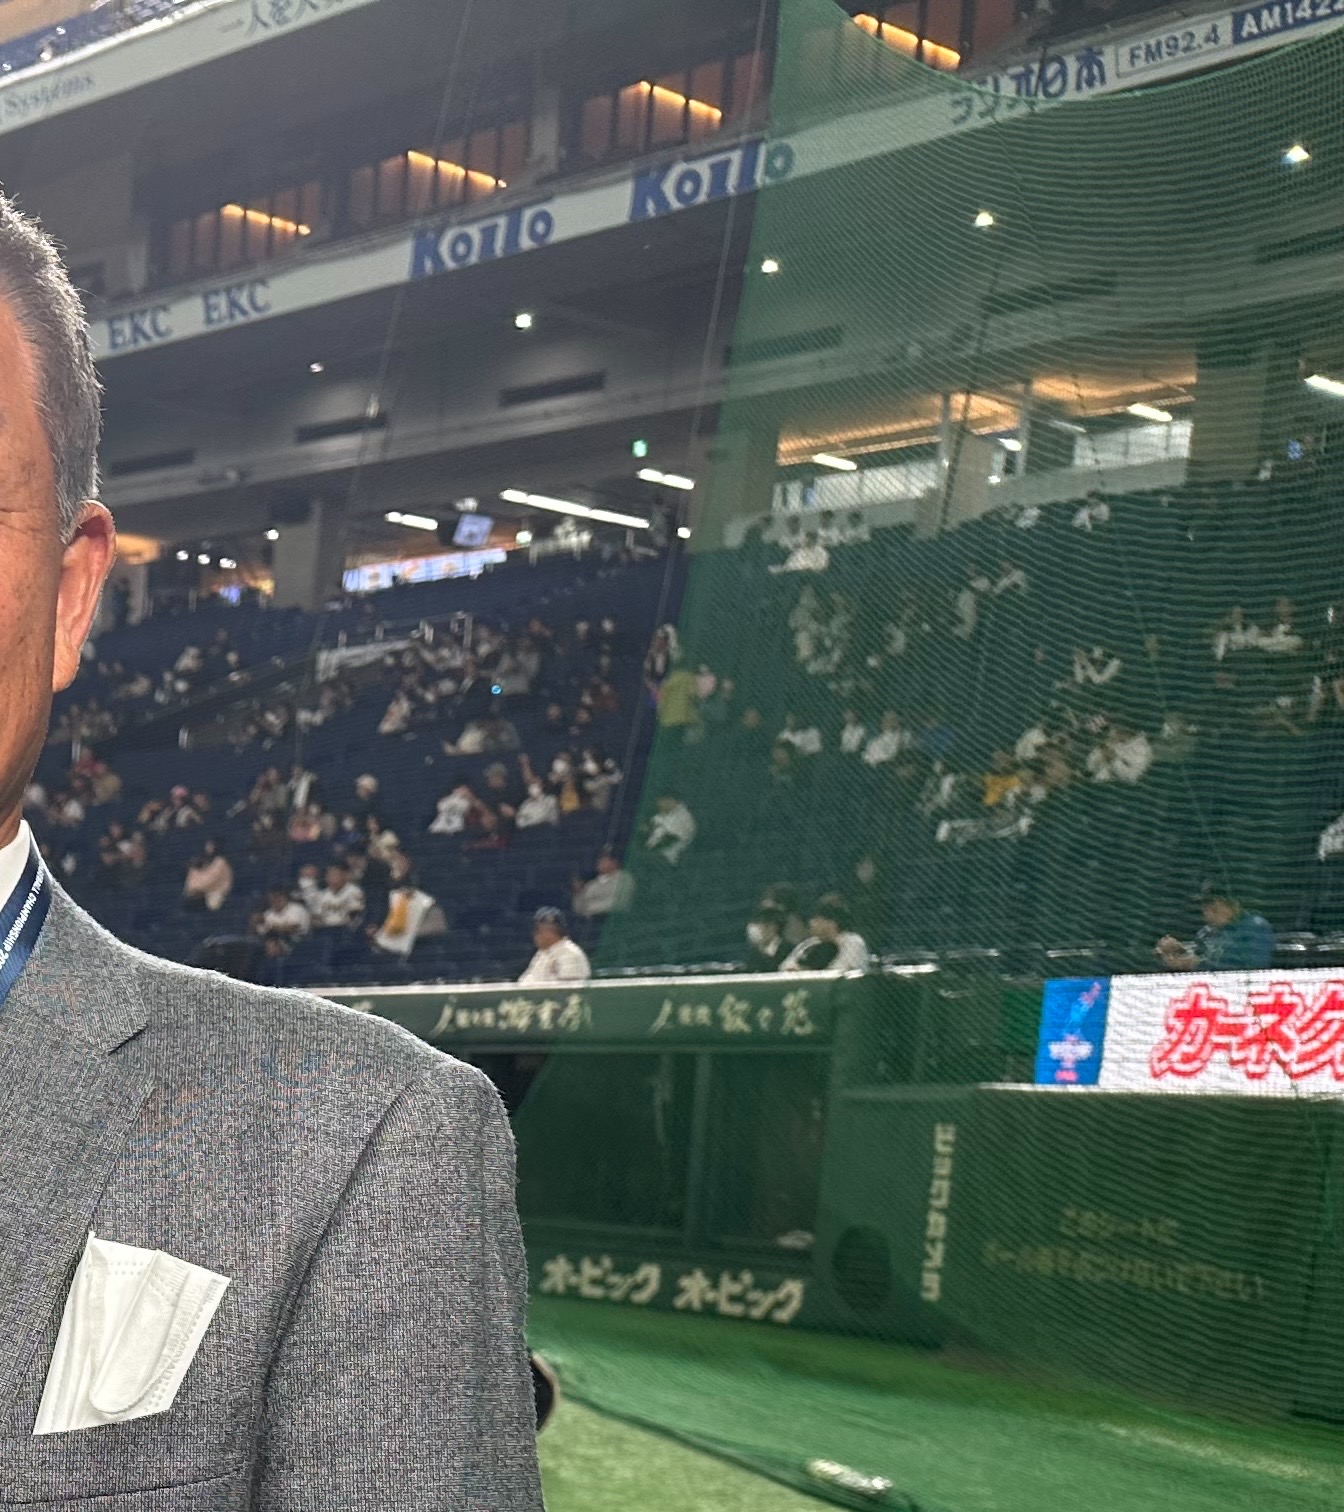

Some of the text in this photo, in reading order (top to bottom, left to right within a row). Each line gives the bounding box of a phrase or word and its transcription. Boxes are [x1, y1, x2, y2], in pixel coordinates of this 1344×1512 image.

[1128, 22, 1220, 68] FM92.4
[202, 280, 271, 324] EKC
[107, 305, 172, 349] EKC
